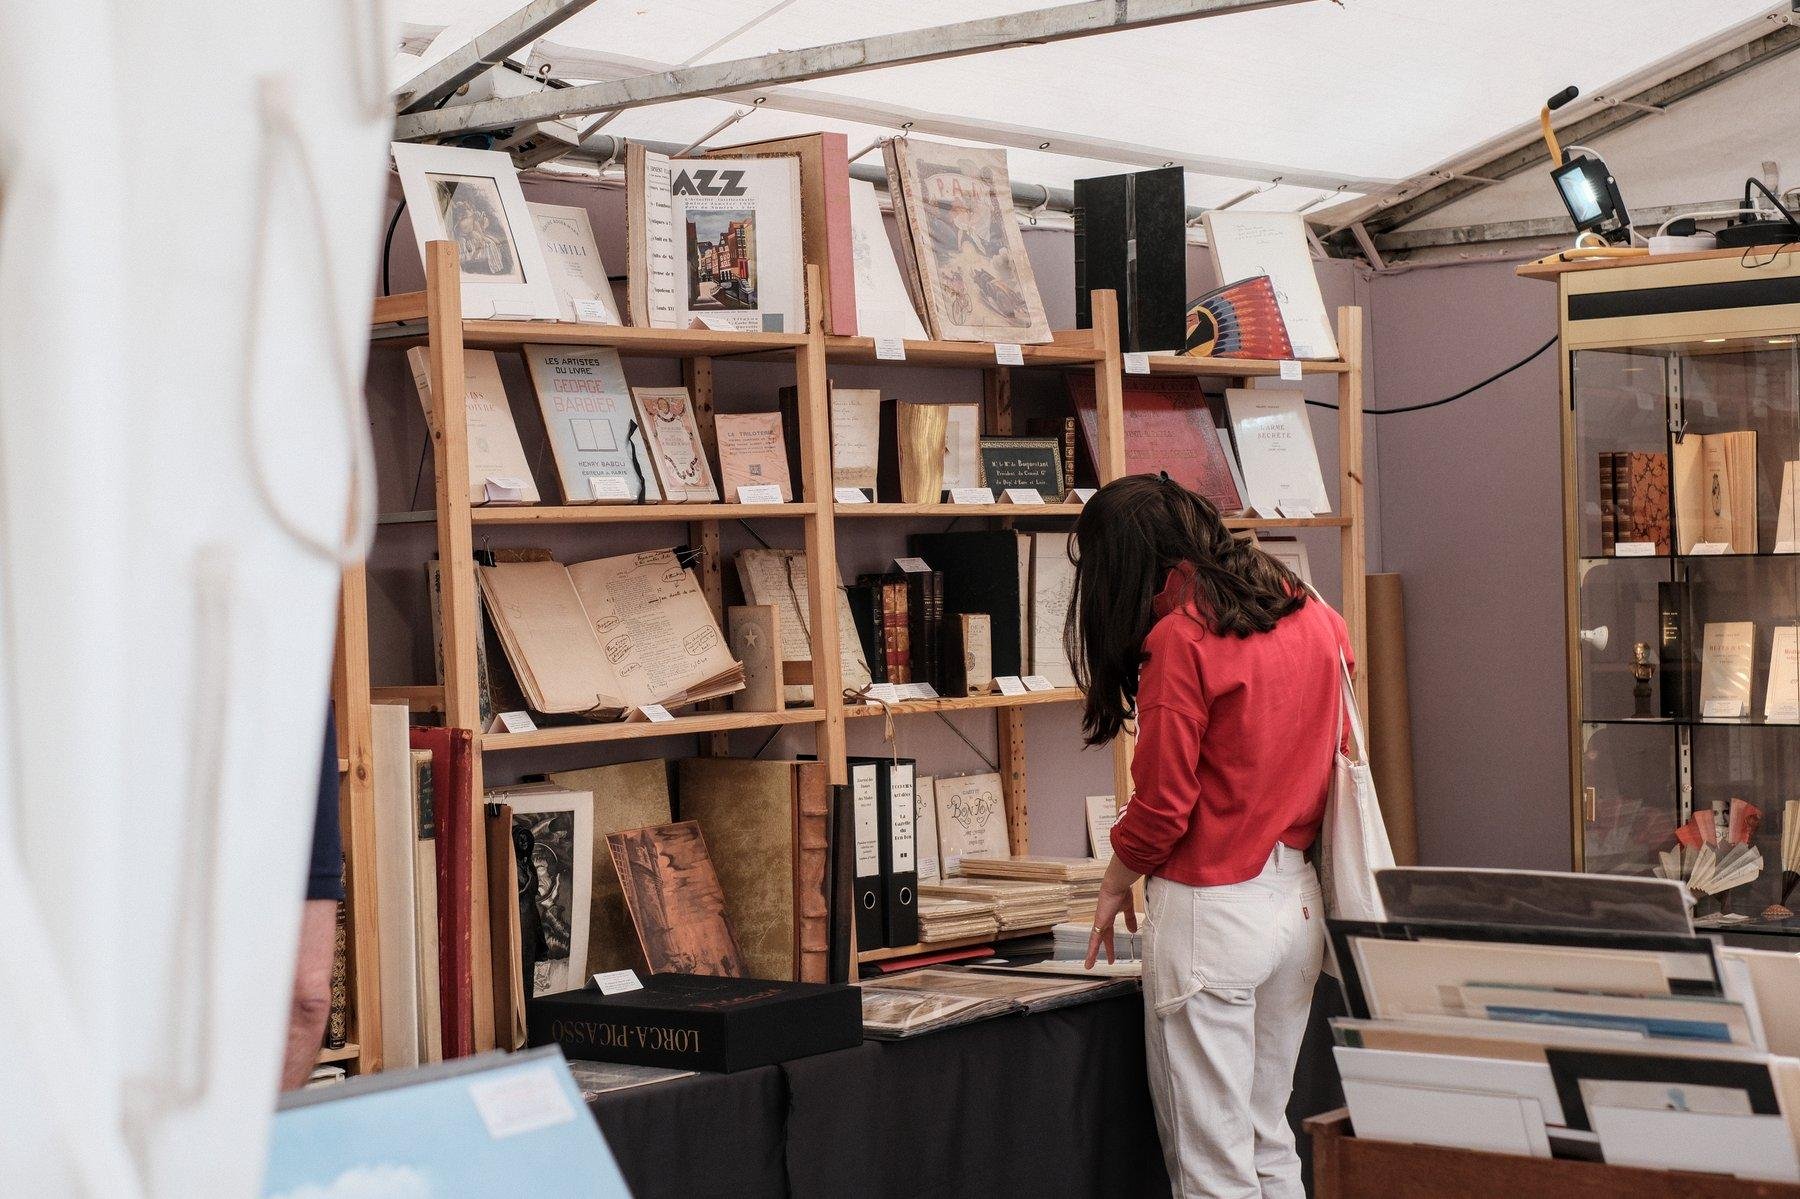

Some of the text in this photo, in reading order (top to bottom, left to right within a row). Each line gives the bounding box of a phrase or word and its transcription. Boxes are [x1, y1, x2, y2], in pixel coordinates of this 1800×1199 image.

[562, 358, 600, 366] ARTISTES
[554, 380, 604, 393] GEORGE
[554, 397, 616, 412] BARBIER
[552, 1019, 700, 1053] LORCA-PICASSO
